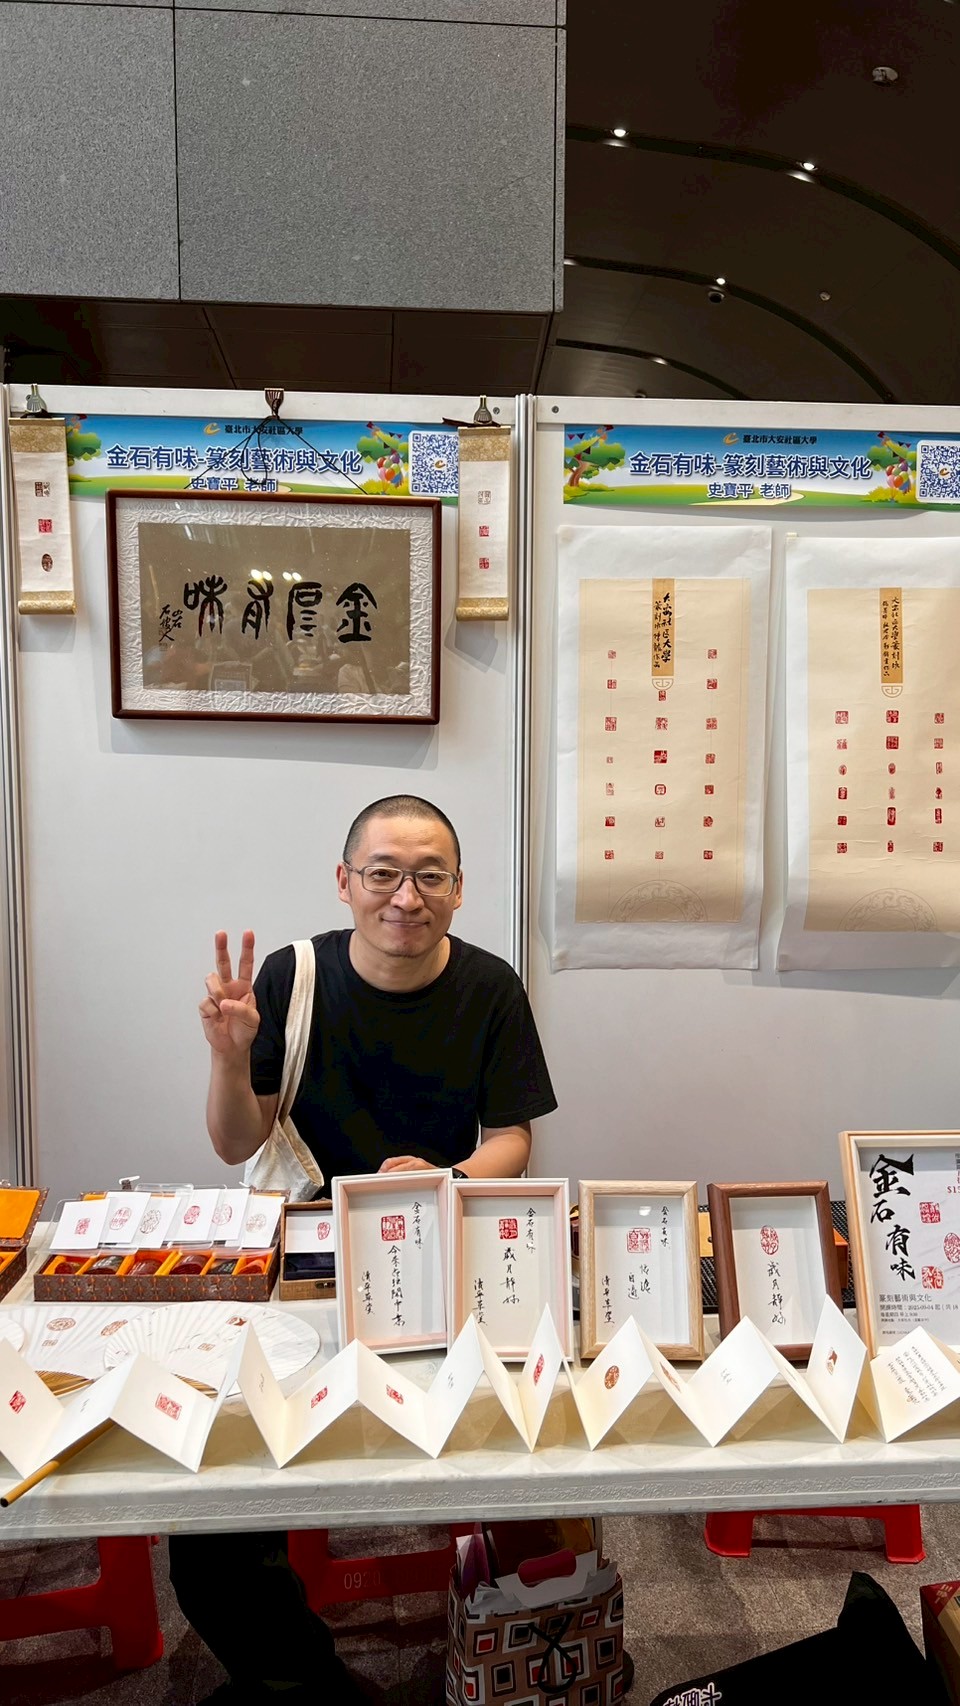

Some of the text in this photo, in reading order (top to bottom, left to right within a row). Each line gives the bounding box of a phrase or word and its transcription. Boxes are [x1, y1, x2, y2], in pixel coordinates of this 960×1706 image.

[224, 424, 303, 435] 臺北市大安社區大學
[742, 434, 817, 446] 臺北市大安社區大學
[106, 444, 363, 474] 金石有味-篆刻藝術與文化
[628, 451, 872, 479] 金石有味-篆刻藝術與文化
[707, 482, 791, 499] 史寶平 老師
[869, 1153, 916, 1281] 金石有味
